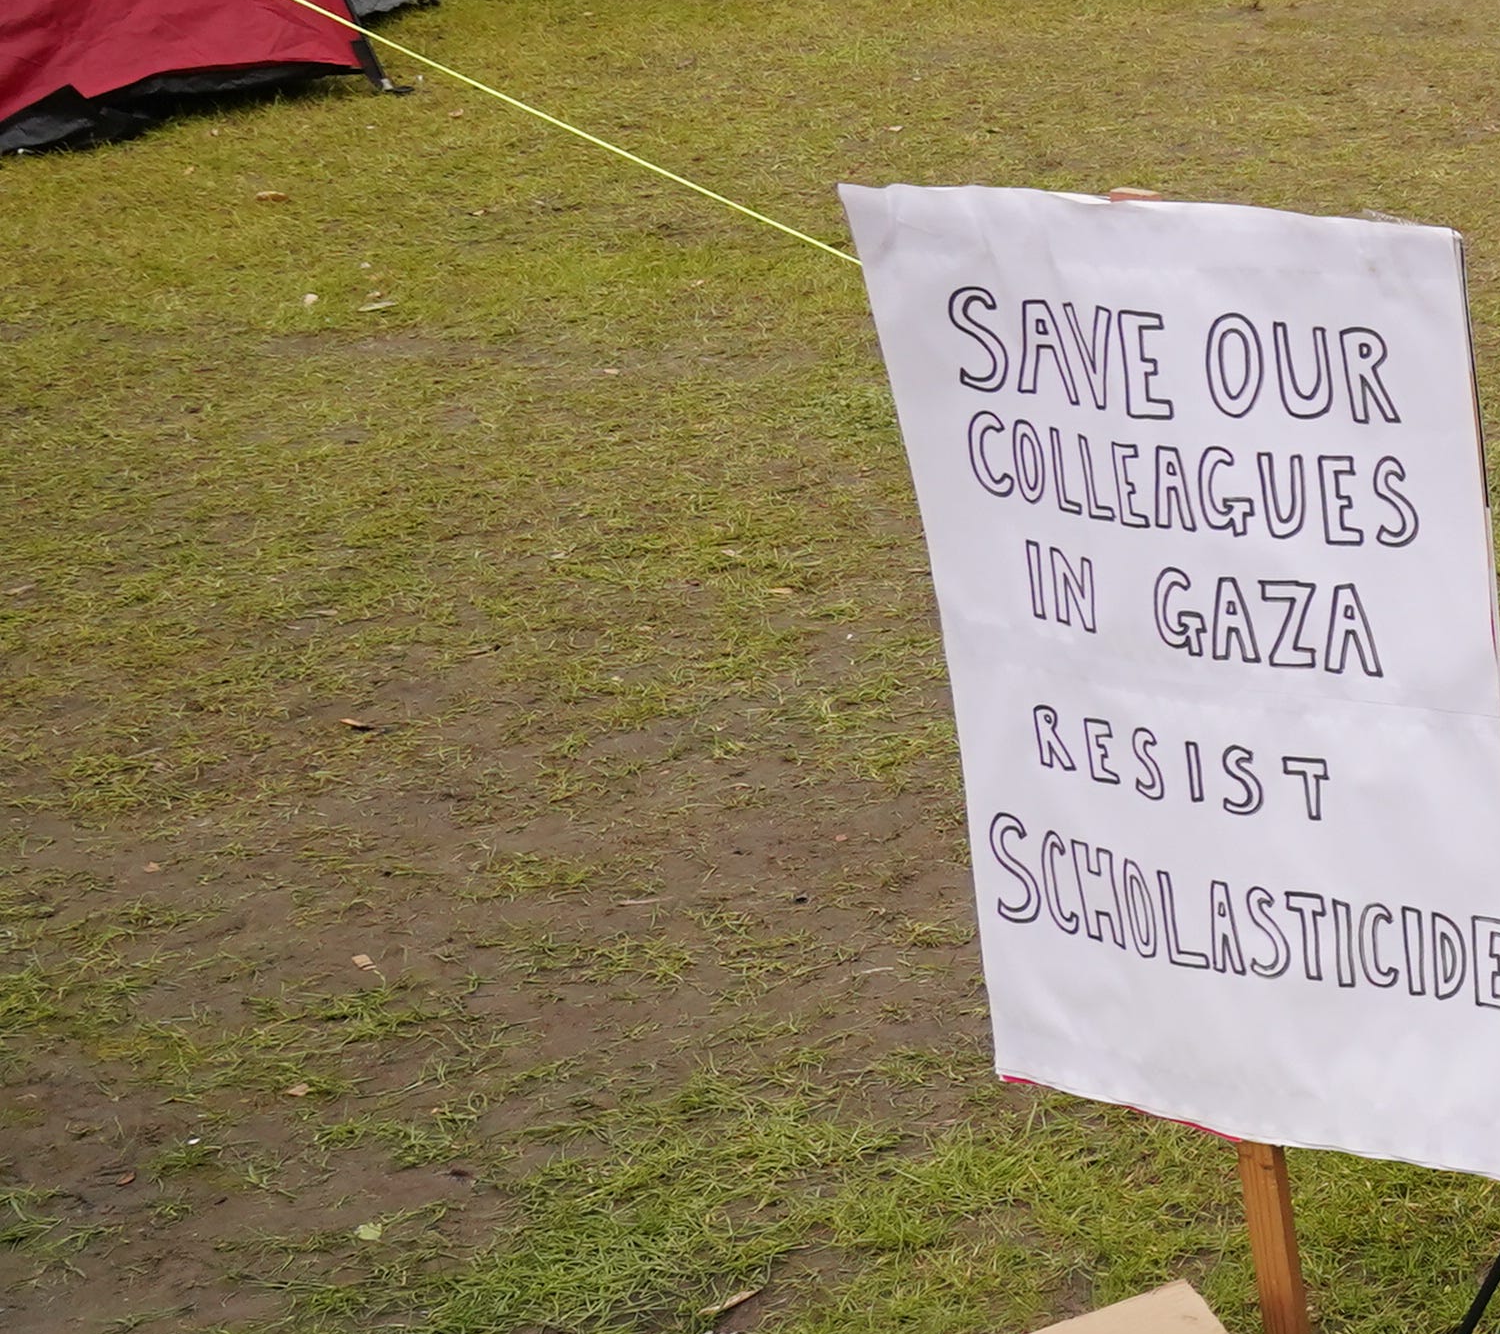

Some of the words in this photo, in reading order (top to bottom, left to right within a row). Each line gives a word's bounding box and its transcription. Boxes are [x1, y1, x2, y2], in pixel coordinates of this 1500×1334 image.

[947, 285, 1175, 421] SAVE
[1205, 312, 1401, 425] OUR
[966, 410, 1420, 549] COLLEAGUES
[1024, 540, 1096, 634] IN
[1152, 567, 1384, 678] GAZA
[1032, 704, 1332, 822] RESIST
